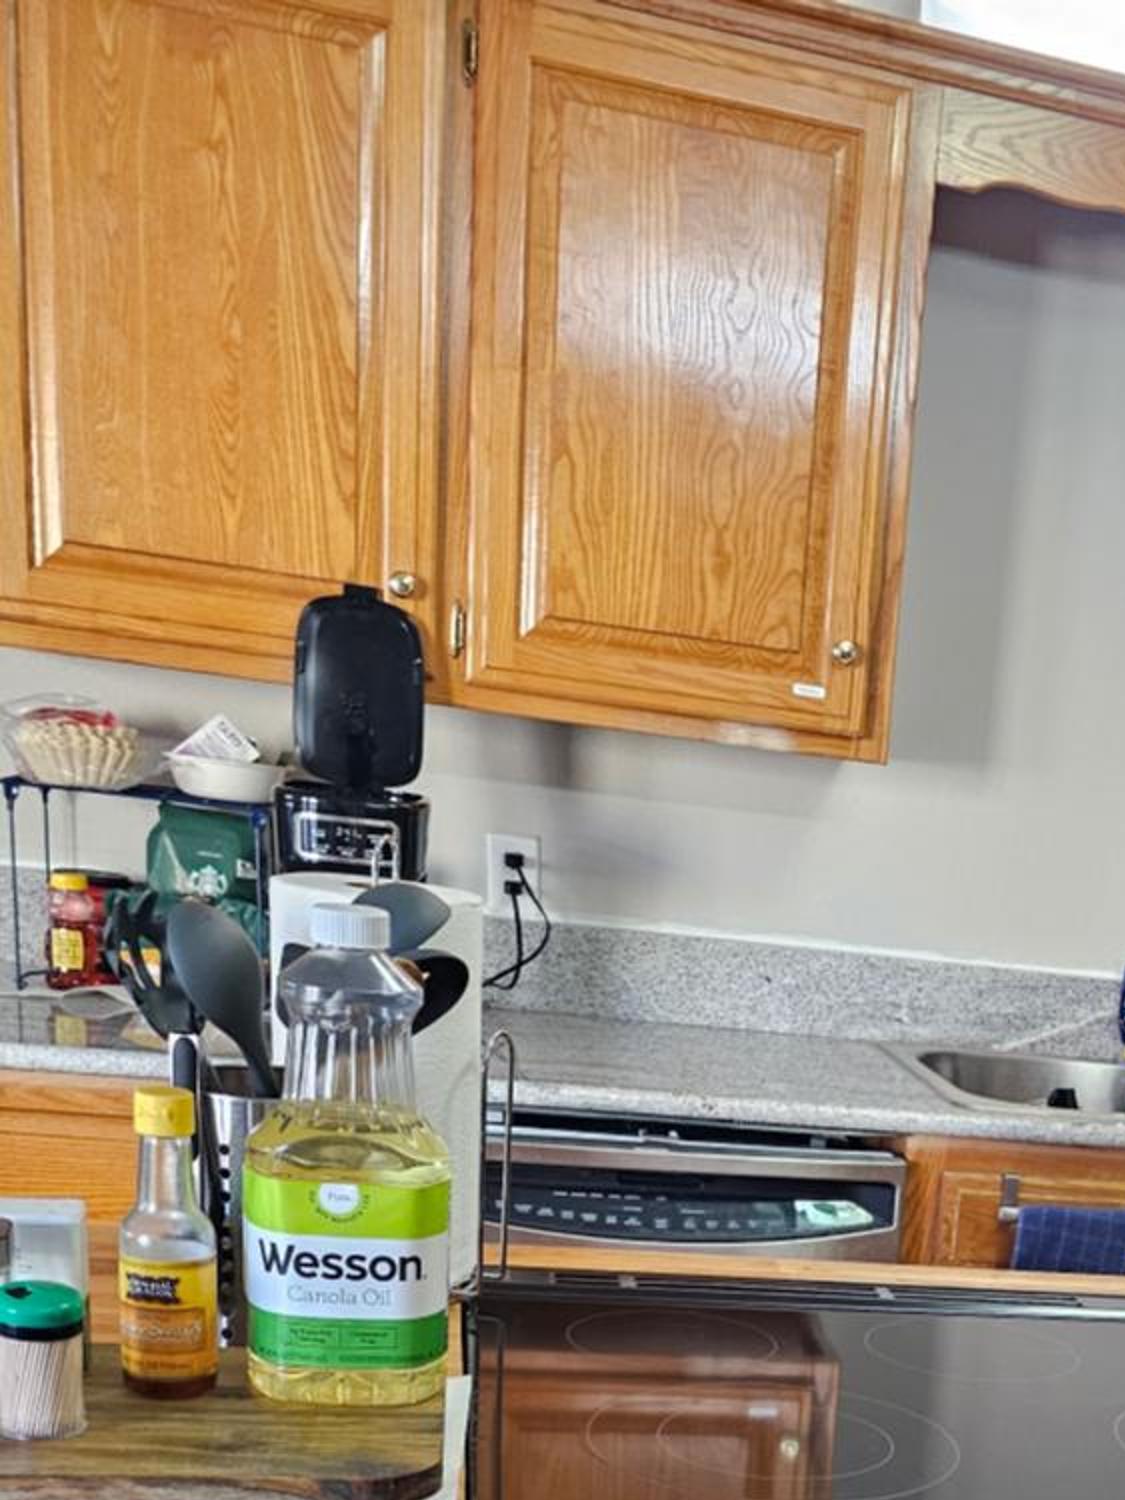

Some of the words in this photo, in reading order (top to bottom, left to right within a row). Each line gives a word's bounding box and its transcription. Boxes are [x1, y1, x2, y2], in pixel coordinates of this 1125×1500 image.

[258, 1237, 423, 1282] Wesson
[287, 1285, 357, 1306] Canola
[361, 1287, 392, 1307] Oil
